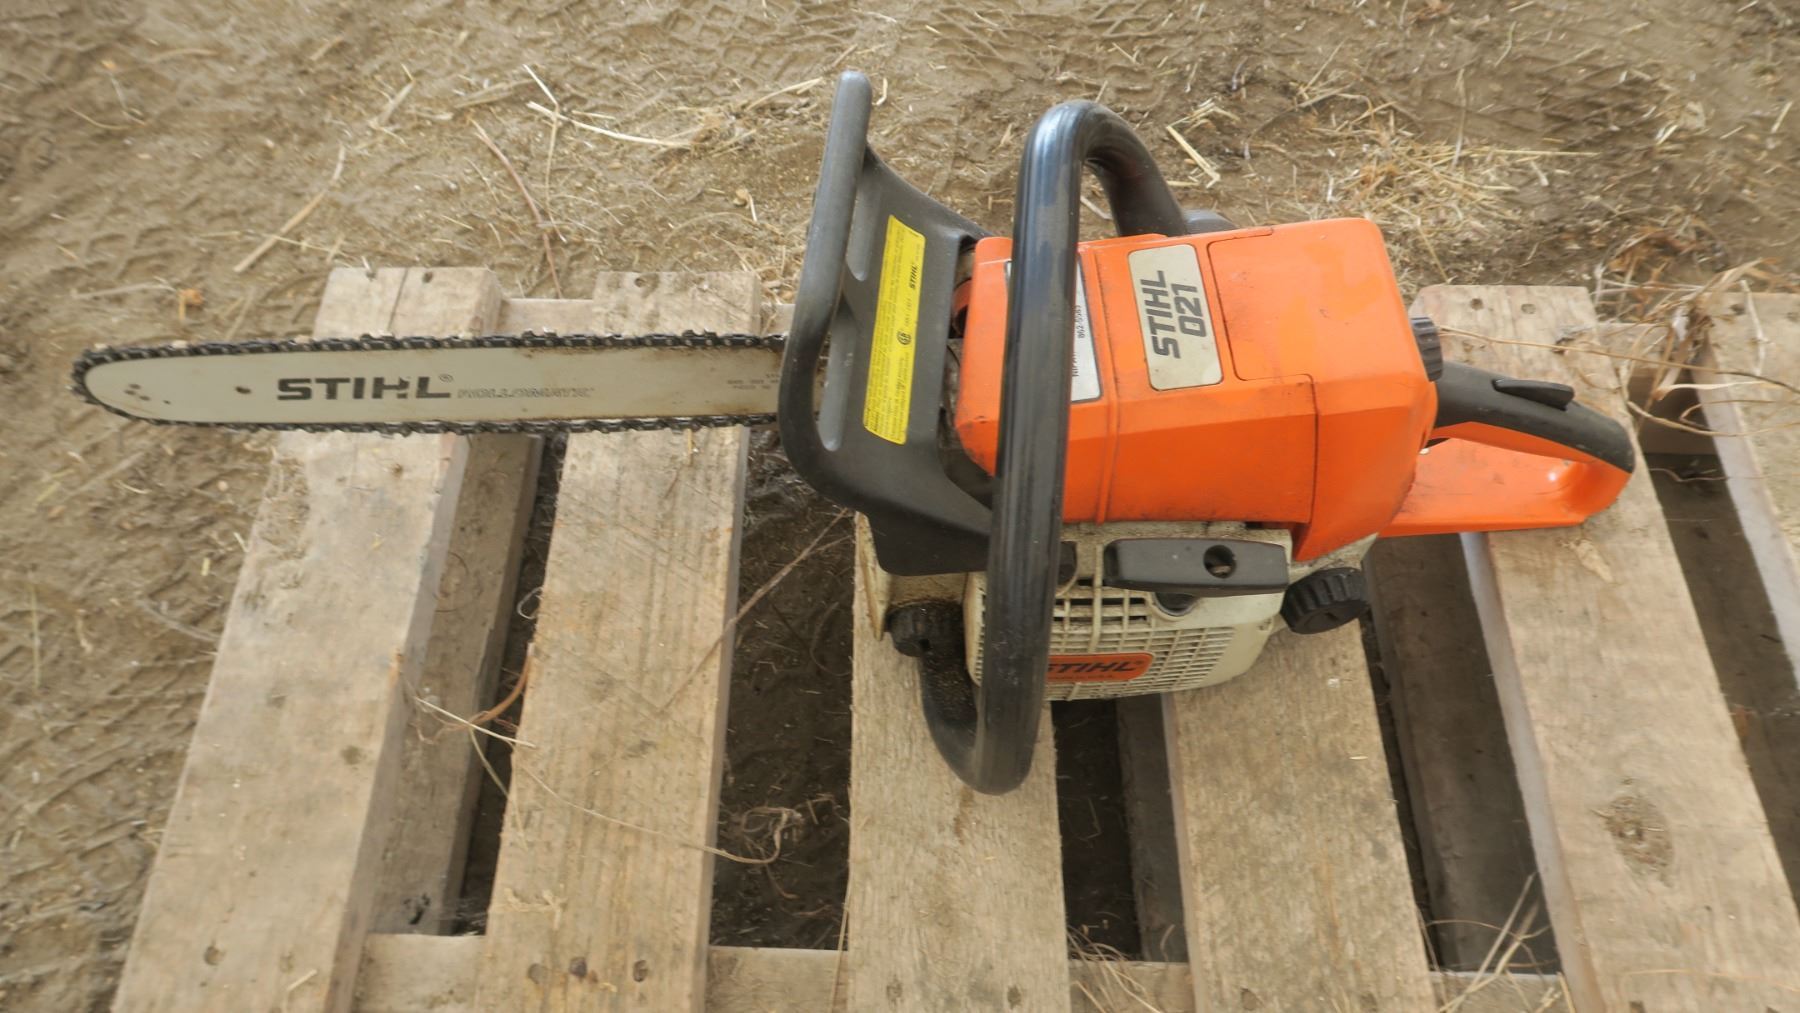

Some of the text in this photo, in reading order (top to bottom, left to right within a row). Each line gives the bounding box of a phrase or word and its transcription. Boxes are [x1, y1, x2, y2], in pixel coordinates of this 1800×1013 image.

[909, 265, 918, 289] STIHL
[1140, 270, 1181, 359] STIHL
[1171, 283, 1207, 337] 021
[277, 376, 450, 400] STIHL
